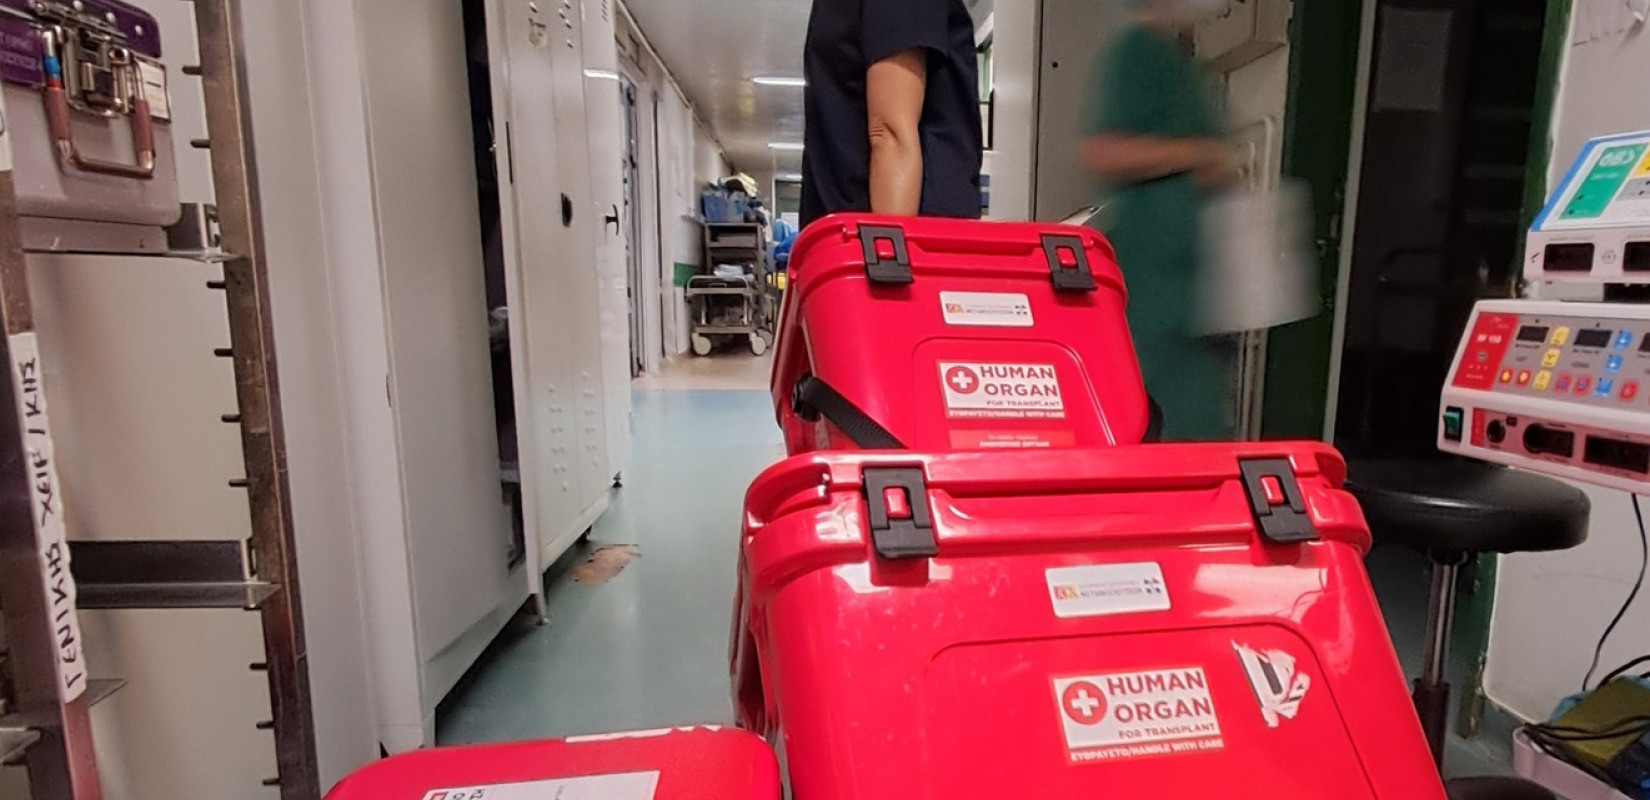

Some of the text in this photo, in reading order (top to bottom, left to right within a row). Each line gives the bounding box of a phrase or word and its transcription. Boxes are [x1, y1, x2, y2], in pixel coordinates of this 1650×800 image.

[980, 365, 1055, 379] HUMAN
[984, 383, 1059, 397] ORGAN
[1007, 400, 1061, 408] TRANSPLANT
[1107, 670, 1205, 696] HUMAN
[1114, 697, 1212, 723] ORGAN
[1119, 722, 1216, 740] FOR TRANSPLANT
[1172, 740, 1198, 753] WITH
[1199, 738, 1225, 750] CARE
